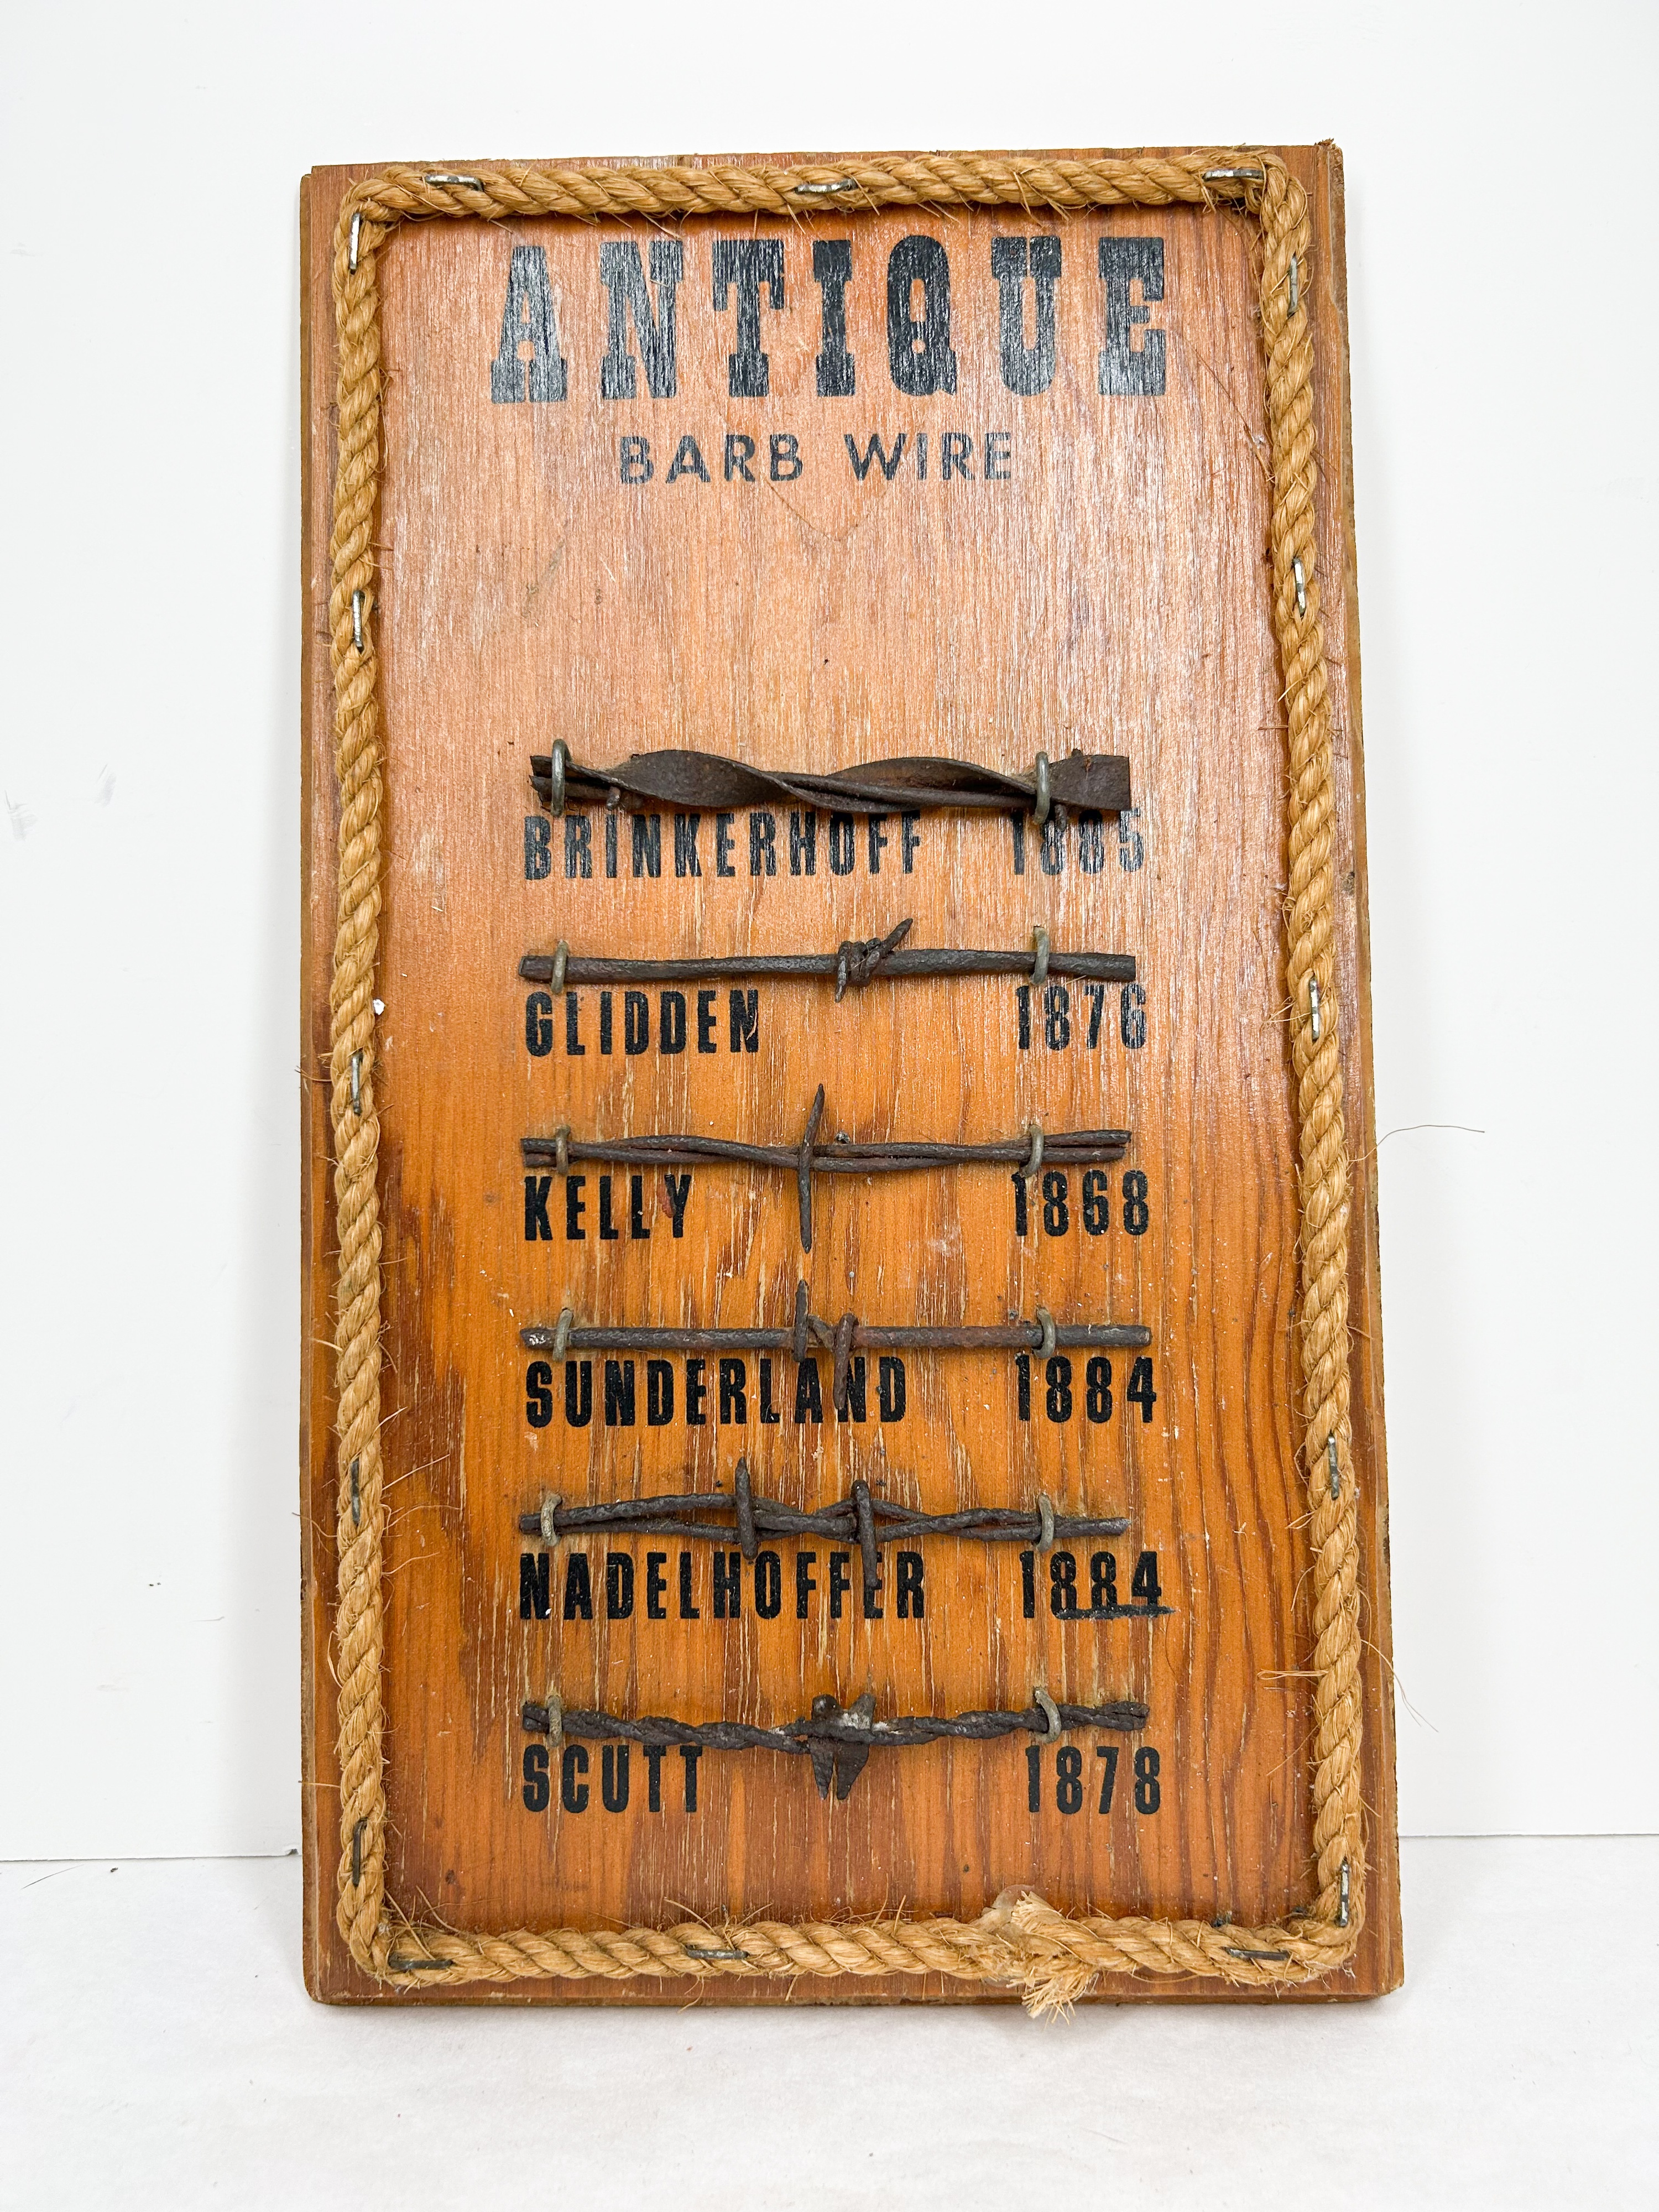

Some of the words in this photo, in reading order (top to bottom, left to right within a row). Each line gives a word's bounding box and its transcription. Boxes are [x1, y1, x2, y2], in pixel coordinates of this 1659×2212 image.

[491, 234, 1166, 403] ANTIQUE
[620, 433, 804, 484] BARB
[843, 432, 1012, 481] WIRE
[523, 808, 921, 880] BRINKERHOFF
[526, 990, 759, 1056] GLIDDEN
[1016, 984, 1147, 1051] 1876
[524, 1175, 692, 1241] KELLY
[1013, 1169, 1149, 1237] 1868
[525, 1356, 906, 1428] SUNDERLAND
[1015, 1355, 1157, 1425] 1884
[519, 1551, 925, 1620] NADELHOFFER
[1020, 1550, 1164, 1619] 1884
[523, 1744, 703, 1814] SCUTT
[1025, 1745, 1160, 1814] 1878
